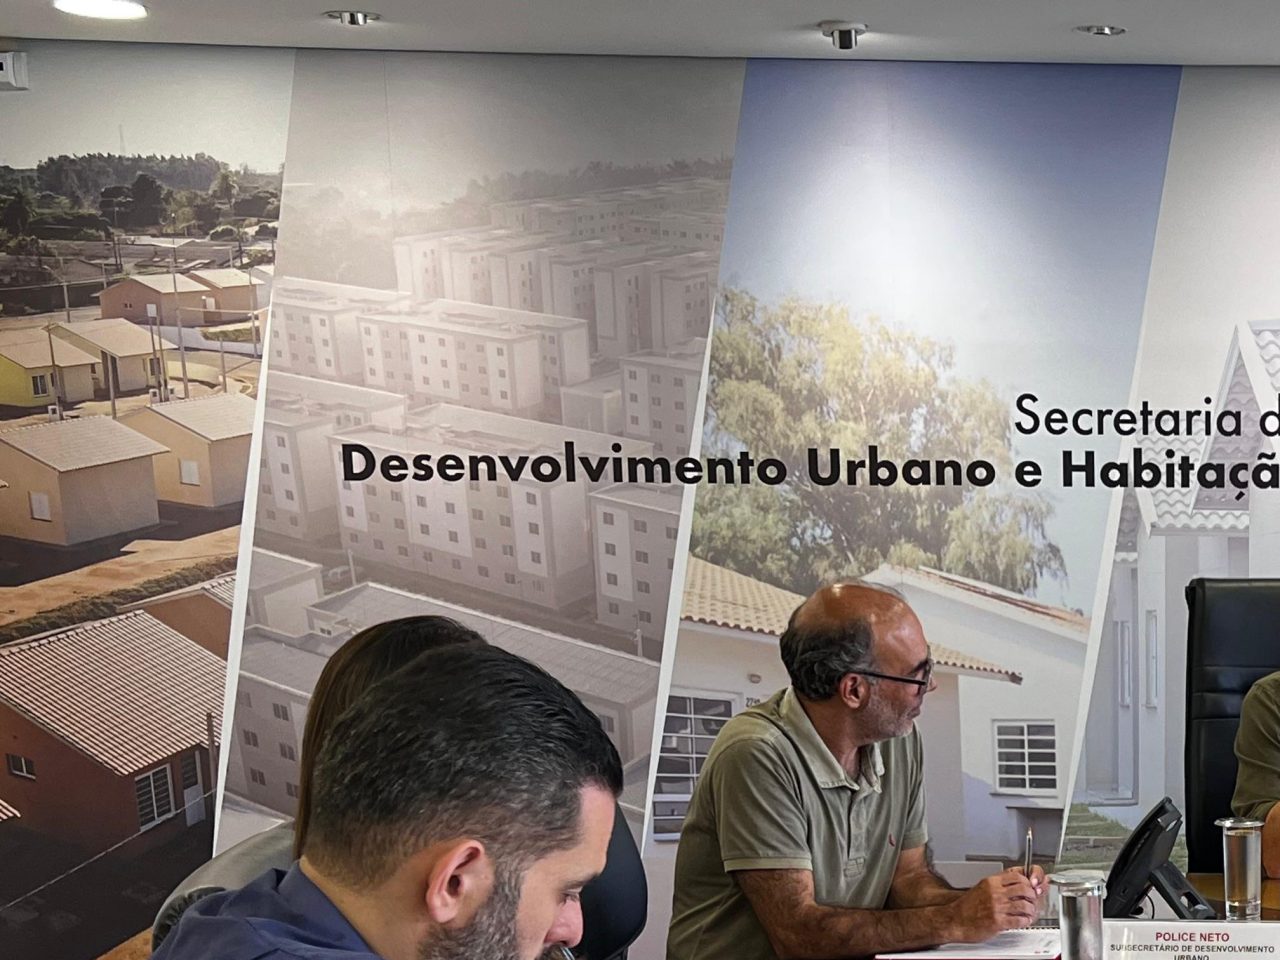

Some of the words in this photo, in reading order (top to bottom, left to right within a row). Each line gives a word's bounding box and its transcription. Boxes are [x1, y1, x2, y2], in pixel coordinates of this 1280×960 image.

[1015, 393, 1242, 437] Secretaria
[341, 442, 788, 486] Desenvolvimento
[807, 446, 996, 487] Urbano
[1015, 460, 1042, 488] e
[1155, 932, 1196, 942] POLICE
[1199, 932, 1230, 942] NETO
[1181, 945, 1192, 953] DE
[1195, 945, 1275, 954] DESENVOLVIMENTO
